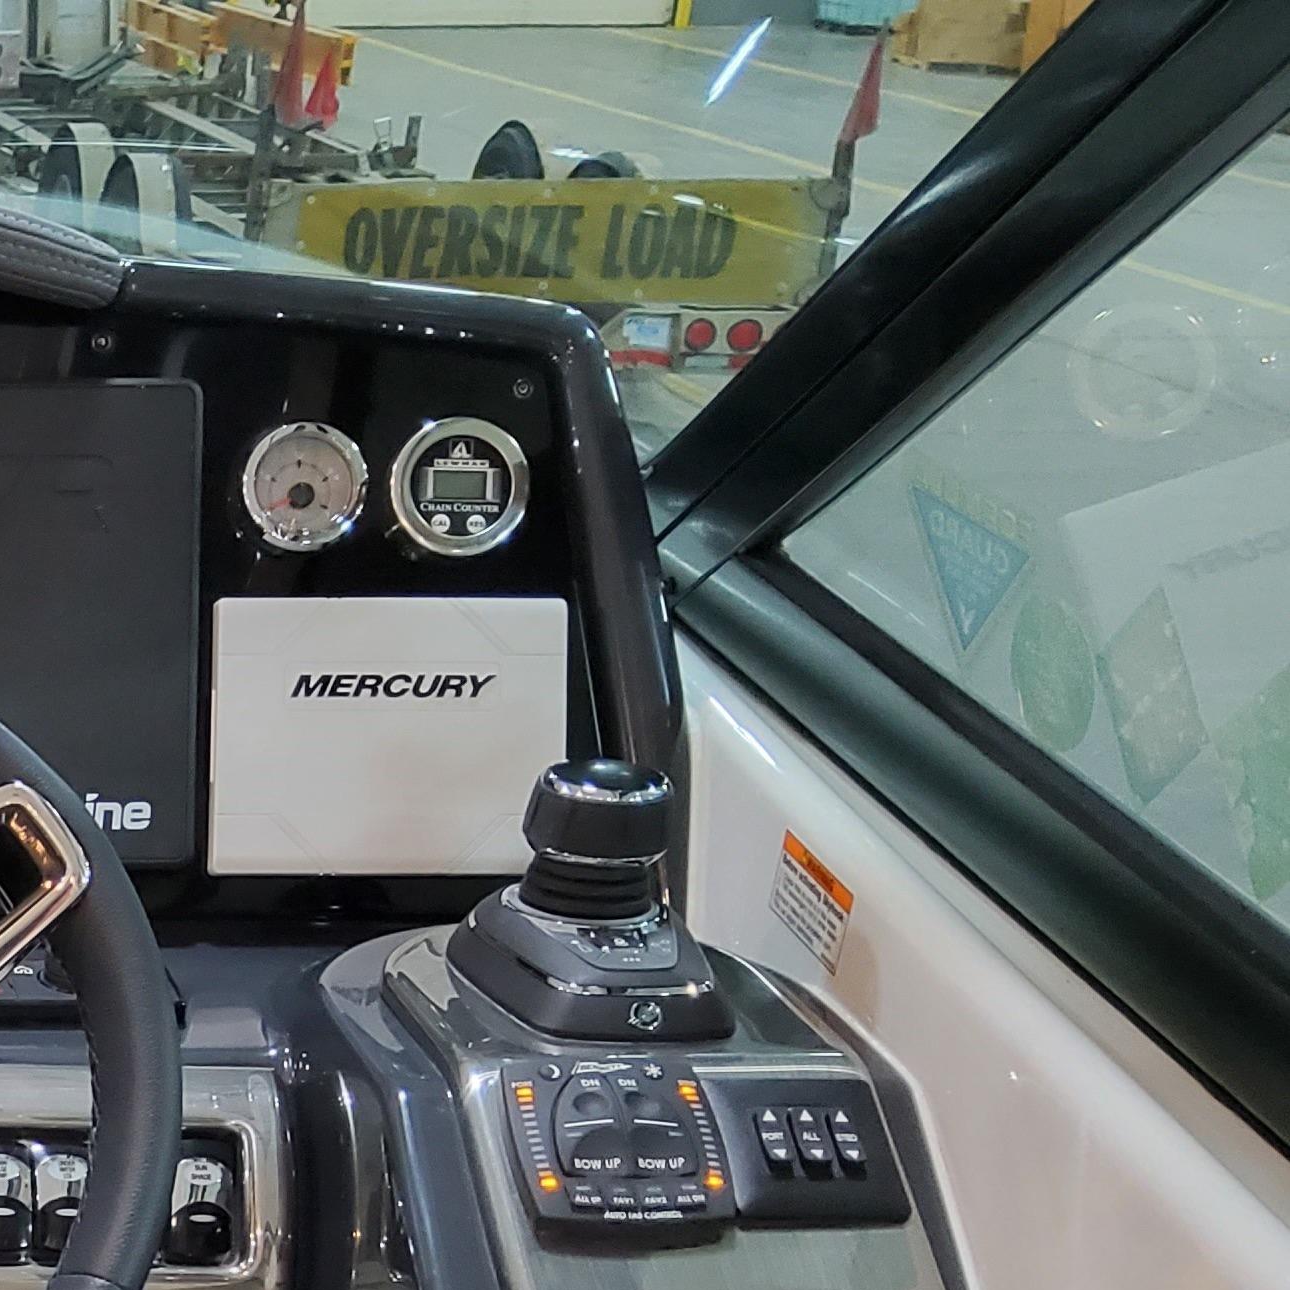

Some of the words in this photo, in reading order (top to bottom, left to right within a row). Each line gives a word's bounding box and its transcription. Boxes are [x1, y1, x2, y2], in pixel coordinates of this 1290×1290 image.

[343, 204, 585, 281] OVERSIZE
[601, 204, 739, 281] LOAD
[420, 502, 452, 512] CHAIN
[453, 502, 500, 513] COUNTER
[290, 674, 497, 698] MERCURY
[580, 1078, 601, 1087] DN
[617, 1078, 637, 1087] DN
[802, 1131, 821, 1141] ALL
[574, 1157, 601, 1170] BOW
[605, 1157, 621, 1169] UP
[638, 1157, 667, 1170] BOW
[669, 1157, 685, 1169] UP
[604, 1210, 626, 1219] AUTO
